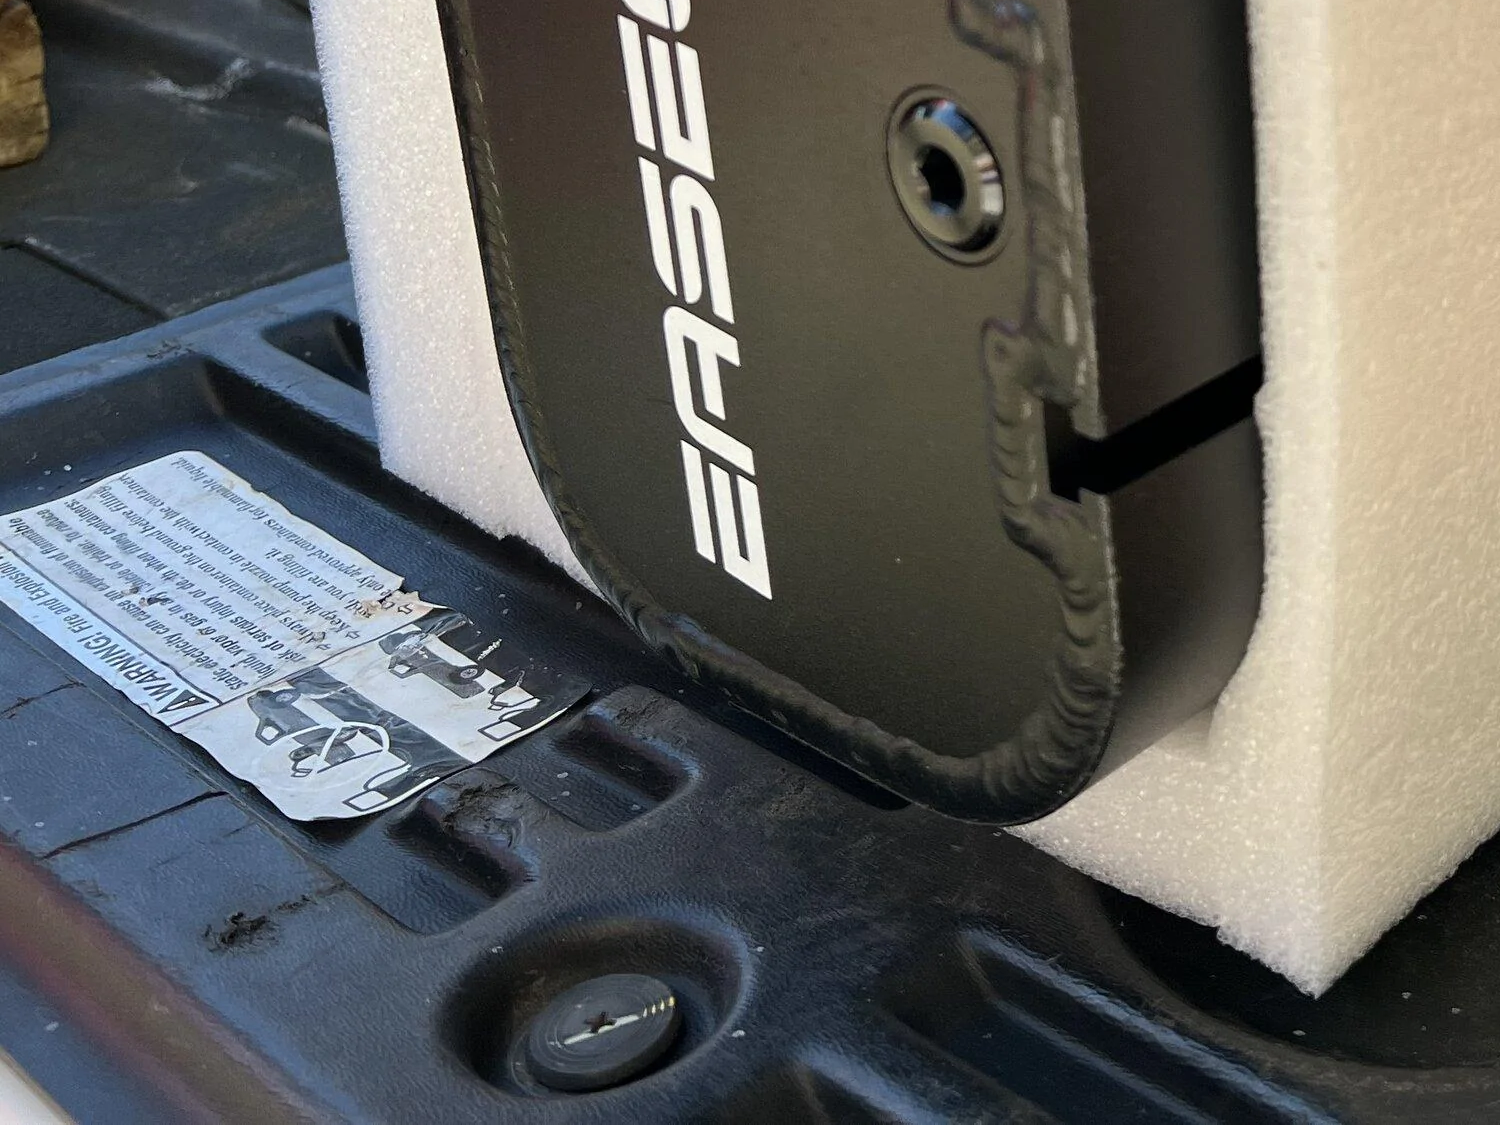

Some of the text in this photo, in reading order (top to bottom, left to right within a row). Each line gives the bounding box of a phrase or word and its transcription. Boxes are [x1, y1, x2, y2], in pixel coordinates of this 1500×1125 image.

[202, 478, 254, 512] flammable
[36, 508, 72, 532] reduce
[122, 510, 156, 534] before
[159, 506, 181, 521] the
[248, 507, 270, 521] for
[9, 517, 59, 555] flammable
[172, 516, 201, 535] with
[263, 518, 317, 552] containers
[64, 531, 84, 543] To
[110, 532, 143, 555] filling
[145, 529, 193, 554] ground
[193, 530, 234, 555] contact
[46, 552, 69, 562] of
[104, 560, 124, 570] or
[136, 551, 168, 572] when
[181, 552, 204, 566] the
[197, 561, 216, 573] on
[228, 553, 246, 565] in
[276, 553, 313, 579] filling
[307, 549, 362, 578] approved
[62, 559, 111, 592] explosion
[160, 569, 195, 590] deth
[240, 561, 278, 584] nozzle
[307, 575, 330, 588] are
[188, 588, 207, 599] or
[210, 571, 259, 602] container
[272, 580, 312, 603] pump
[324, 585, 354, 601] you
[356, 575, 385, 592] only
[37, 597, 72, 615] and
[103, 590, 124, 602] an
[117, 599, 152, 622] cause
[167, 604, 185, 616] in
[200, 596, 236, 620] injury
[253, 599, 291, 618] place
[301, 600, 323, 615] the
[63, 613, 93, 634] Fire
[145, 619, 170, 635] can
[179, 612, 208, 627] gas
[229, 616, 272, 643] serious
[318, 610, 351, 633] Keep
[197, 626, 217, 636] or
[164, 632, 218, 669] electricity
[210, 635, 246, 657] vapor
[261, 640, 285, 651] of
[277, 648, 307, 663] risk
[79, 632, 177, 701] WARNING!
